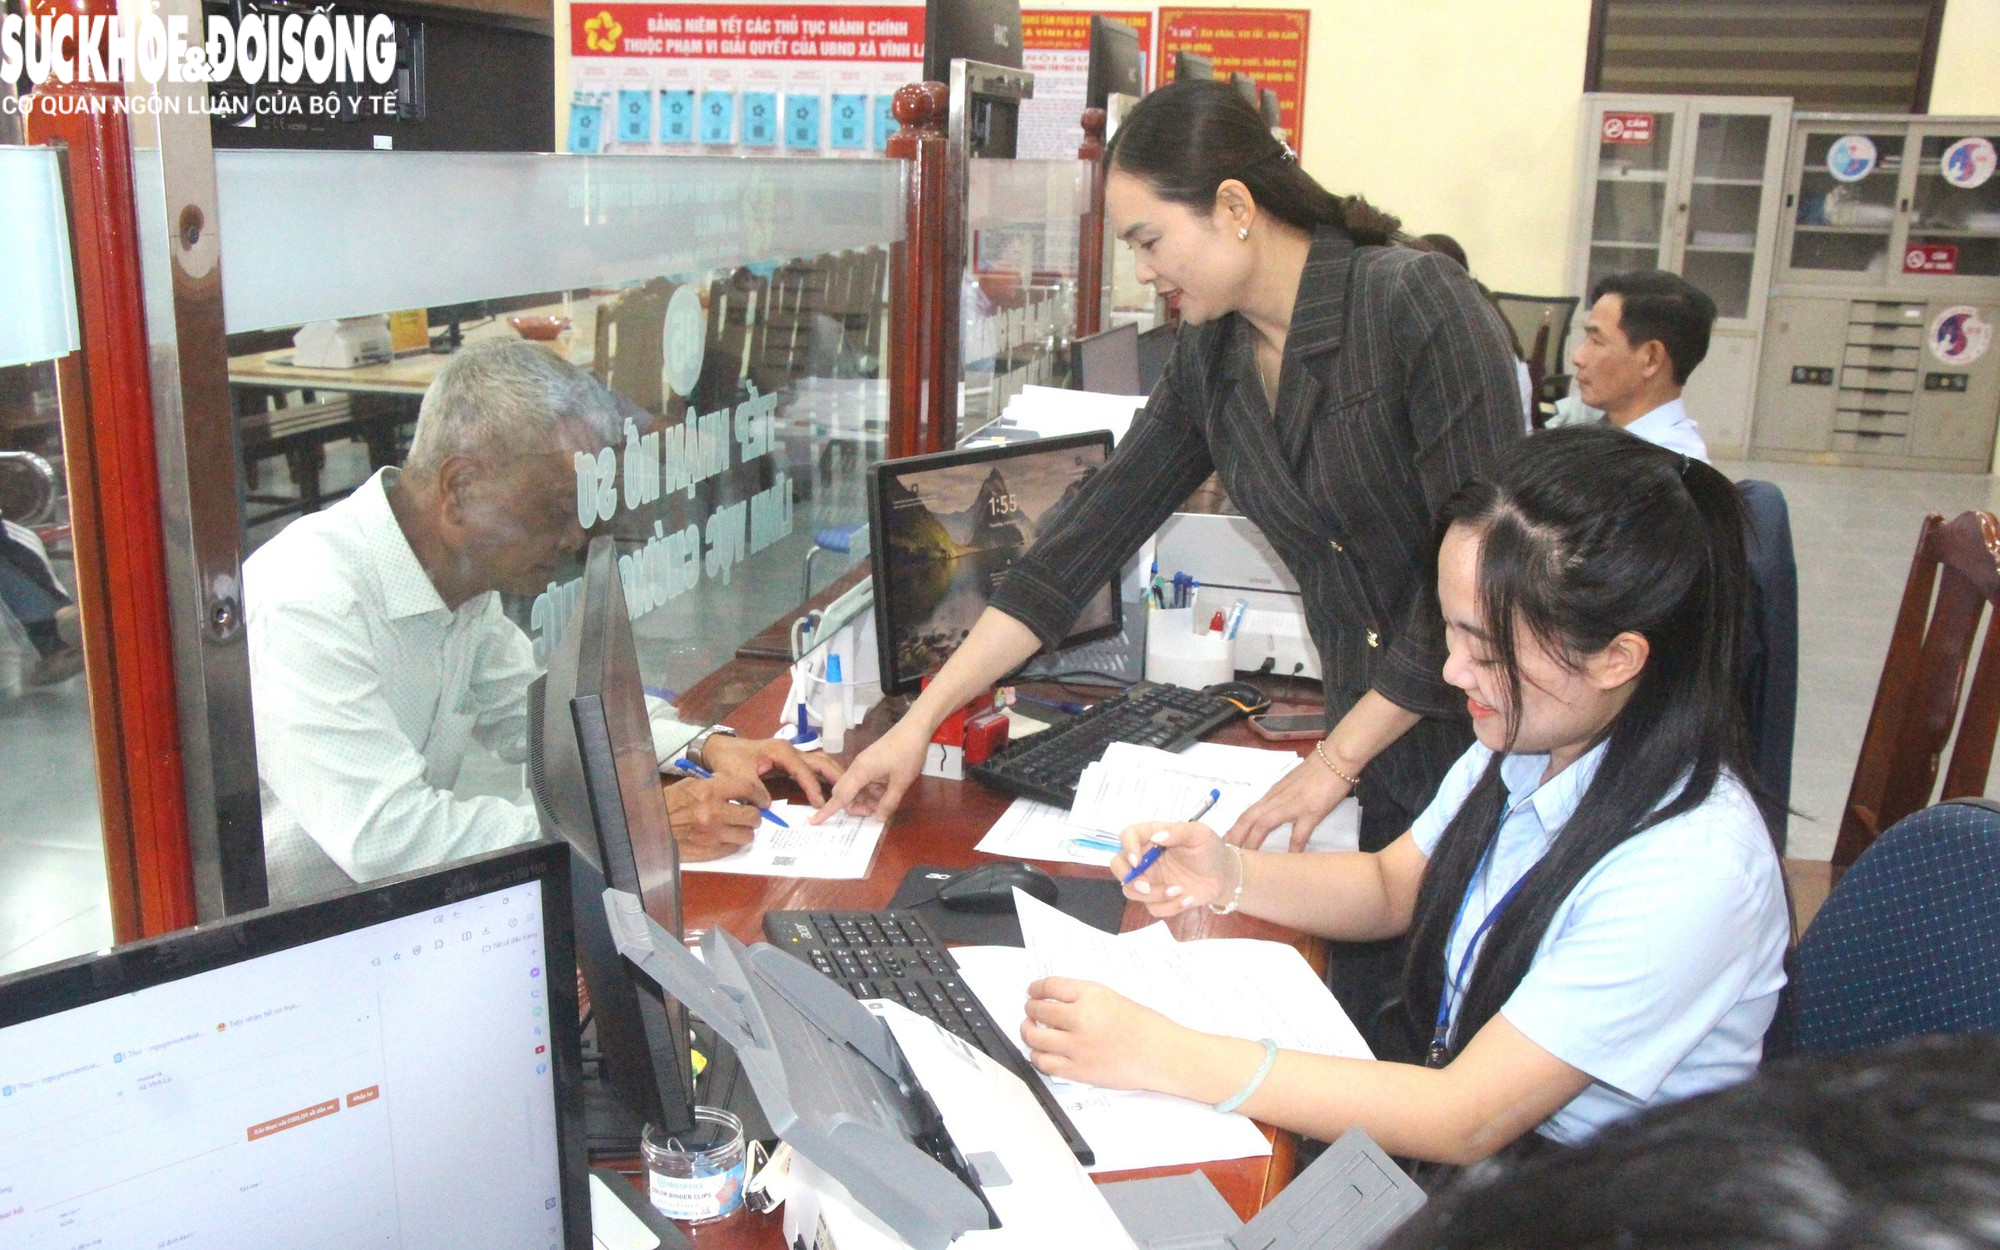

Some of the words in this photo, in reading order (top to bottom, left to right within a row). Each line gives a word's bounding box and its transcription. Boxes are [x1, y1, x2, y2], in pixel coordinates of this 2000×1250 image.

[647, 13, 682, 33] BẢNG
[745, 16, 771, 34] CÁC
[774, 14, 799, 34] THỦ
[801, 19, 826, 37] TỤC
[828, 18, 865, 35] HÀNH
[868, 18, 908, 36] CHÍNH
[705, 39, 718, 54] VI
[791, 35, 817, 56] CỦA
[858, 39, 877, 56] XÃ
[989, 494, 1017, 515] 1:55
